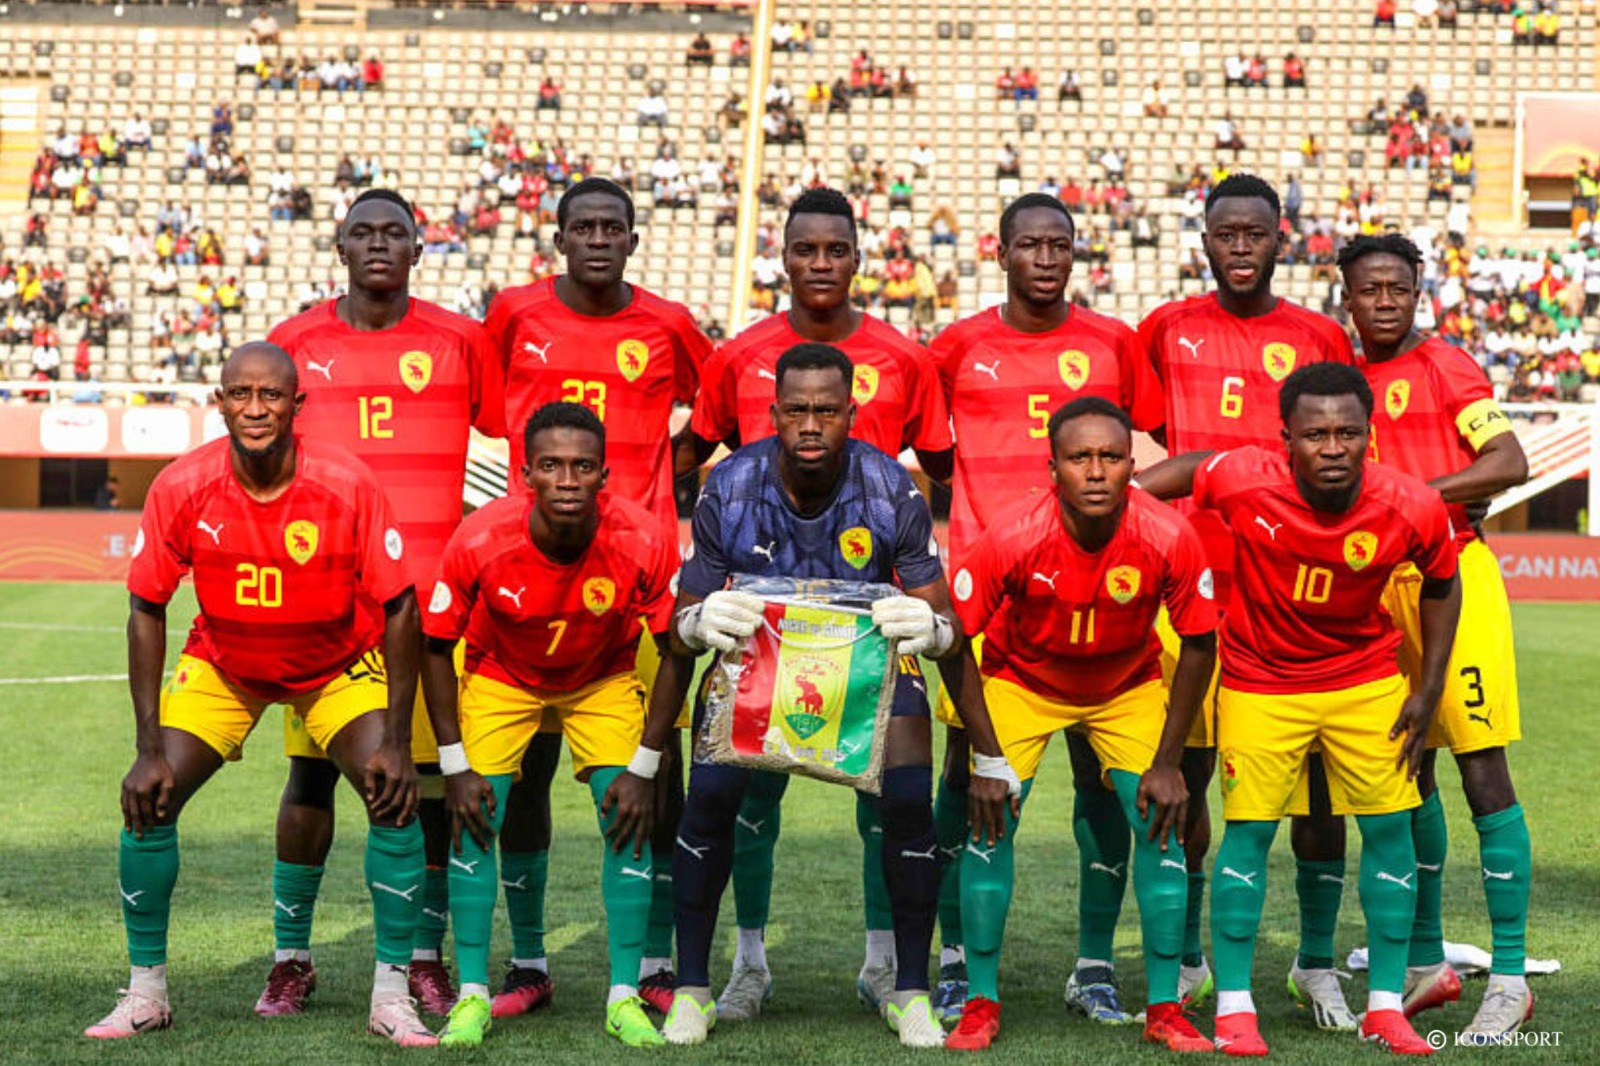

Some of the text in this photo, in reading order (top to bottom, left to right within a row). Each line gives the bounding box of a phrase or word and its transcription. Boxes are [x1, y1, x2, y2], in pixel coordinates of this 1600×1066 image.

[358, 396, 394, 439] 12
[561, 378, 607, 423] 23
[1028, 394, 1050, 438] 5
[1221, 376, 1246, 418] 6
[235, 562, 283, 608] 20
[1293, 562, 1333, 604] 10
[1559, 555, 1600, 578] NA
[546, 619, 568, 656] 7
[1070, 607, 1096, 645] 11
[1460, 666, 1485, 709] 3
